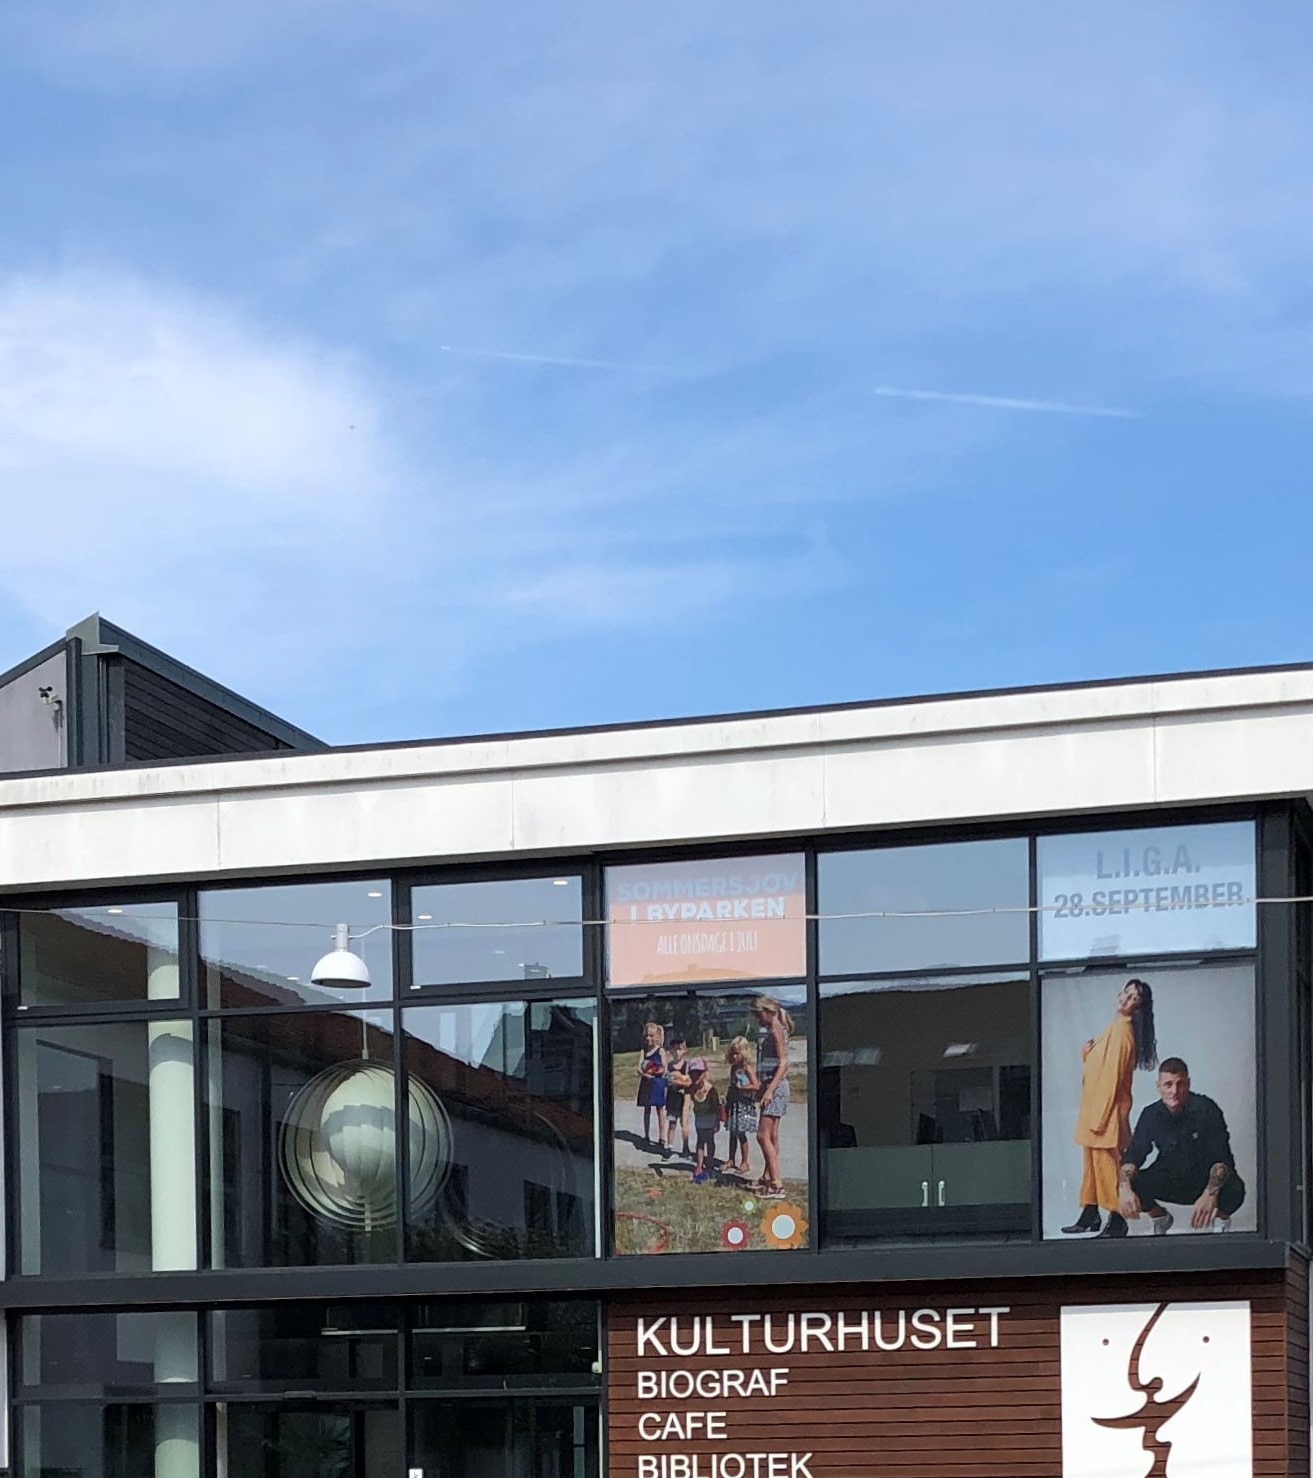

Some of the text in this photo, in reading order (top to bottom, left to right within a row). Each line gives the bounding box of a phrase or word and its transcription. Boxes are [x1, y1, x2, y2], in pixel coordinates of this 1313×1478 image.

[1096, 843, 1201, 880] L.I.G.A.
[617, 872, 800, 903] SOMMERSJOV
[630, 897, 785, 923] I BYPARKEN
[657, 930, 757, 955] ALLE ONSDAGE I JULI
[637, 1307, 1011, 1357] KULTURHUSET
[637, 1368, 790, 1399] BIOGRAF
[638, 1411, 728, 1441] CAFE
